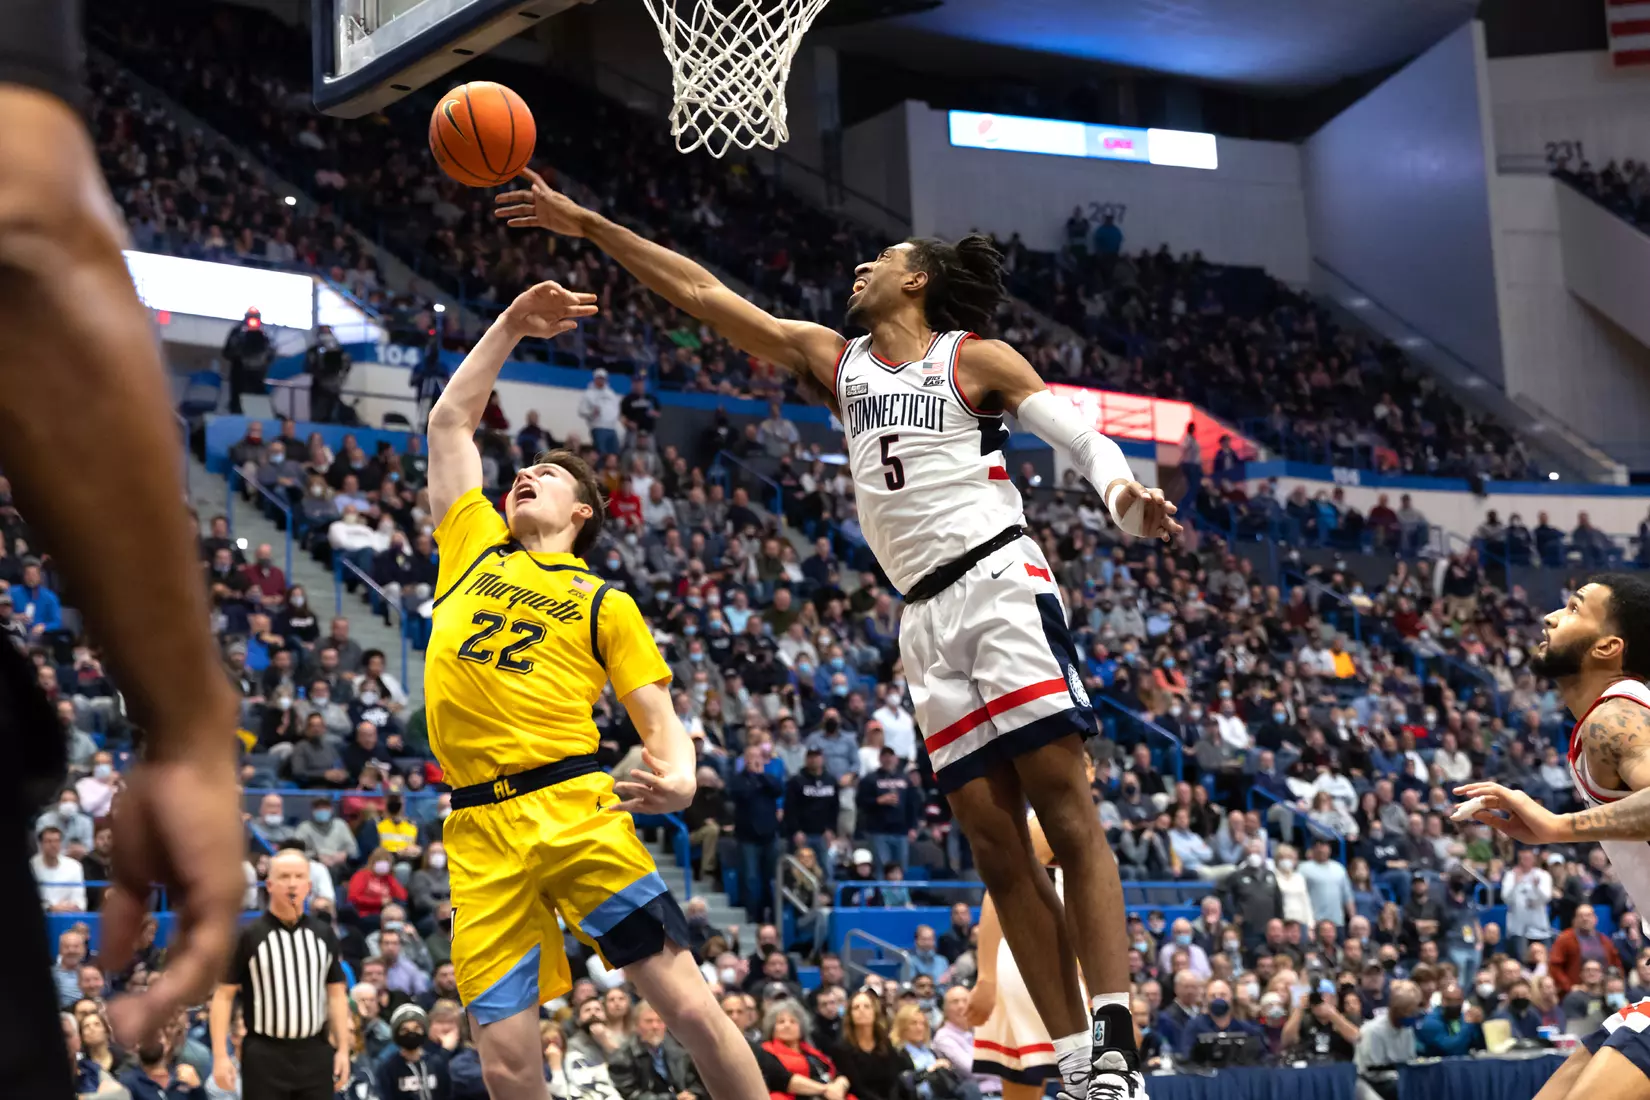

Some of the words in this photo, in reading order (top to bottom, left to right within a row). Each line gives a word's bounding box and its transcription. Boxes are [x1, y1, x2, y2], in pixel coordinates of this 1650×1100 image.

[374, 343, 419, 367] 104
[847, 393, 948, 439] CONNECTICUT
[878, 433, 906, 492] 5
[464, 571, 584, 625] Marquette
[457, 608, 548, 676] 22
[493, 778, 518, 800] AL
